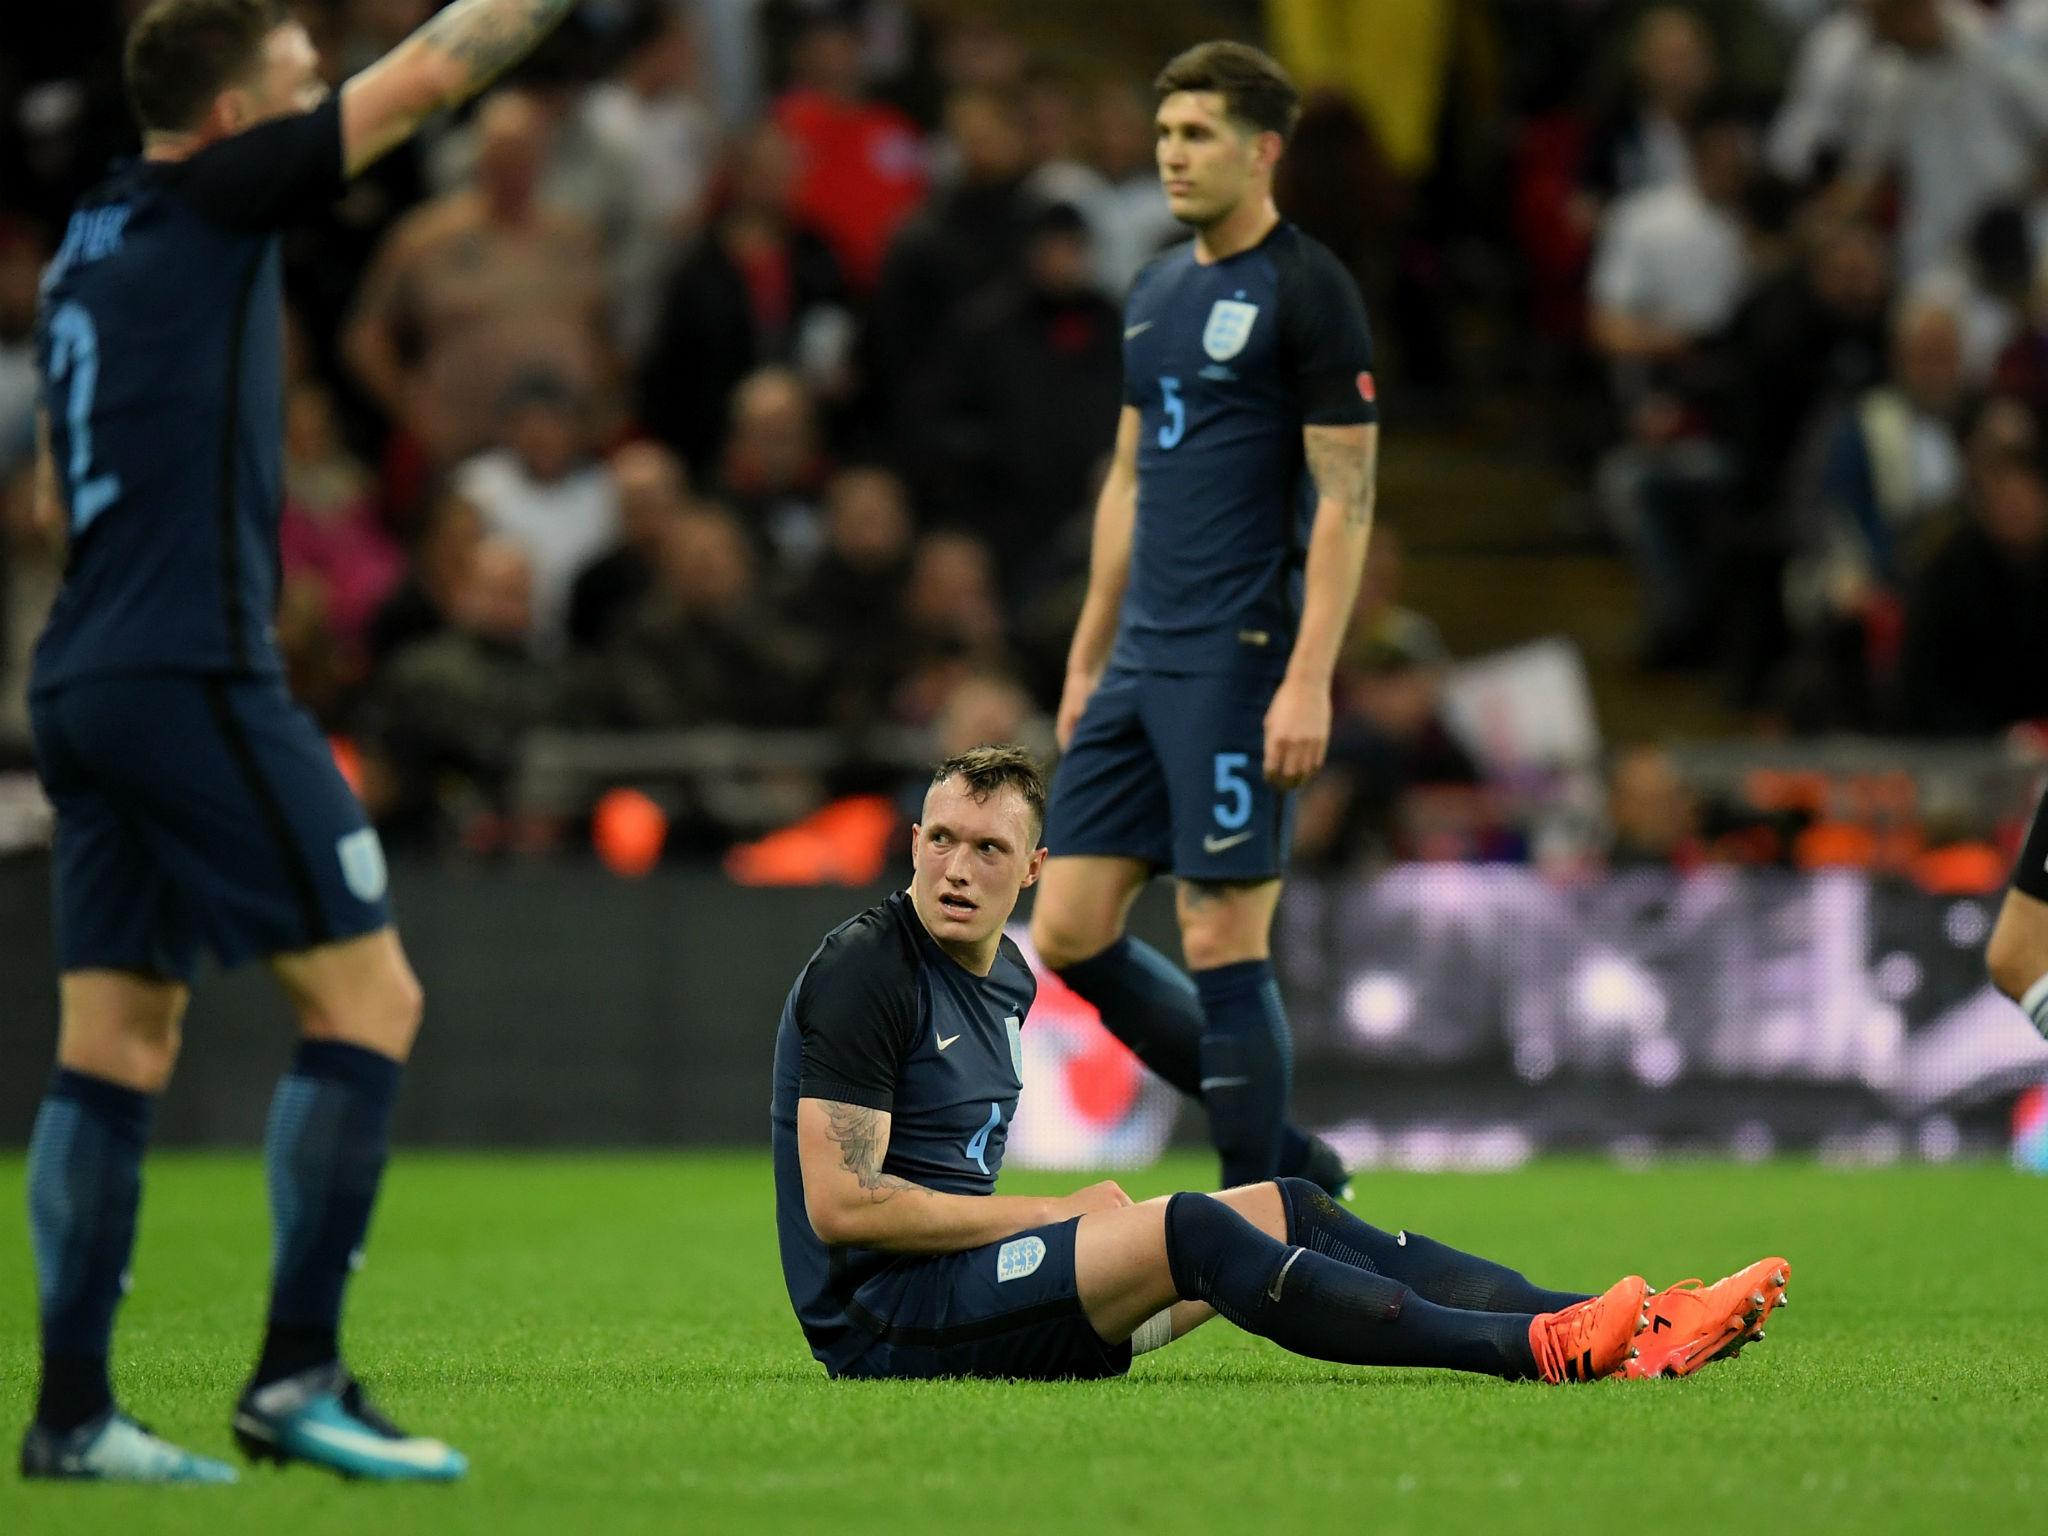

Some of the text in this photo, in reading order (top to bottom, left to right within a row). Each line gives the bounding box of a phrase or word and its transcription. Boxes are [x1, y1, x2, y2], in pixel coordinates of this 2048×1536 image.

[49, 302, 121, 534] 2
[1158, 375, 1185, 450] 5
[1213, 752, 1252, 829] 5
[966, 1102, 1001, 1175] 4
